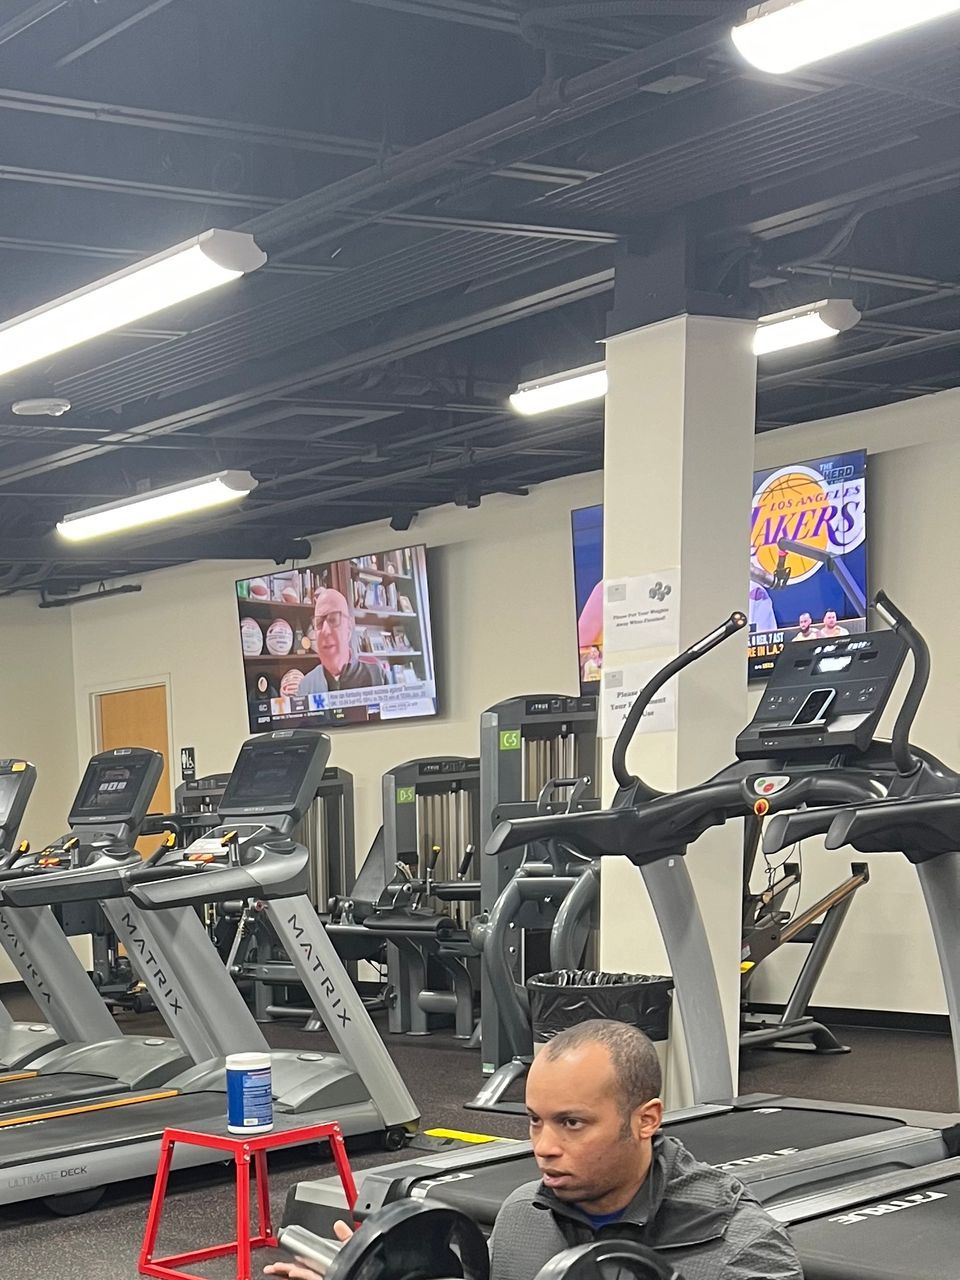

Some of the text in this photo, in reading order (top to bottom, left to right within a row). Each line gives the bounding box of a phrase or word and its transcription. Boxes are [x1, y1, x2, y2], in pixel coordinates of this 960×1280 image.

[823, 466, 854, 481] HERD
[770, 485, 861, 512] LOS ANGELES
[617, 690, 638, 698] Please
[503, 733, 517, 747] C-5
[121, 912, 183, 1017] MATRIX
[288, 913, 352, 1029] MATRIX
[7, 1165, 88, 1188] ULTIMATE DECK
